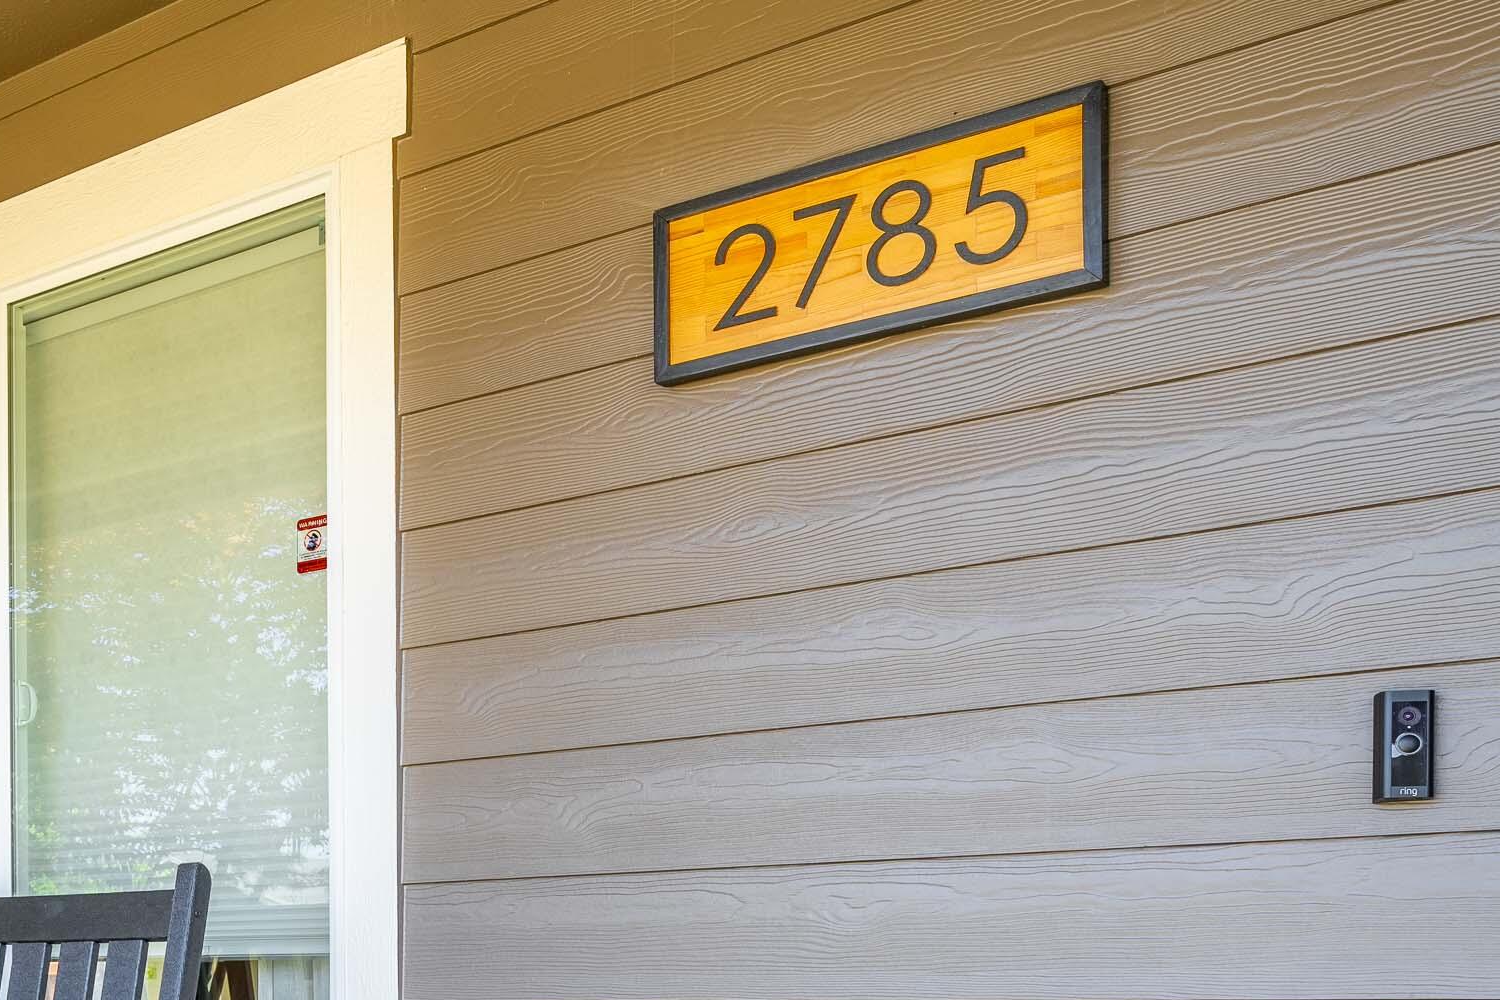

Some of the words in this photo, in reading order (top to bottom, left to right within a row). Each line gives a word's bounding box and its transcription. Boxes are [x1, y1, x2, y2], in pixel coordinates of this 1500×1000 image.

[714, 146, 1028, 331] 2785
[299, 518, 327, 528] WARNING
[1399, 787, 1418, 796] ring
